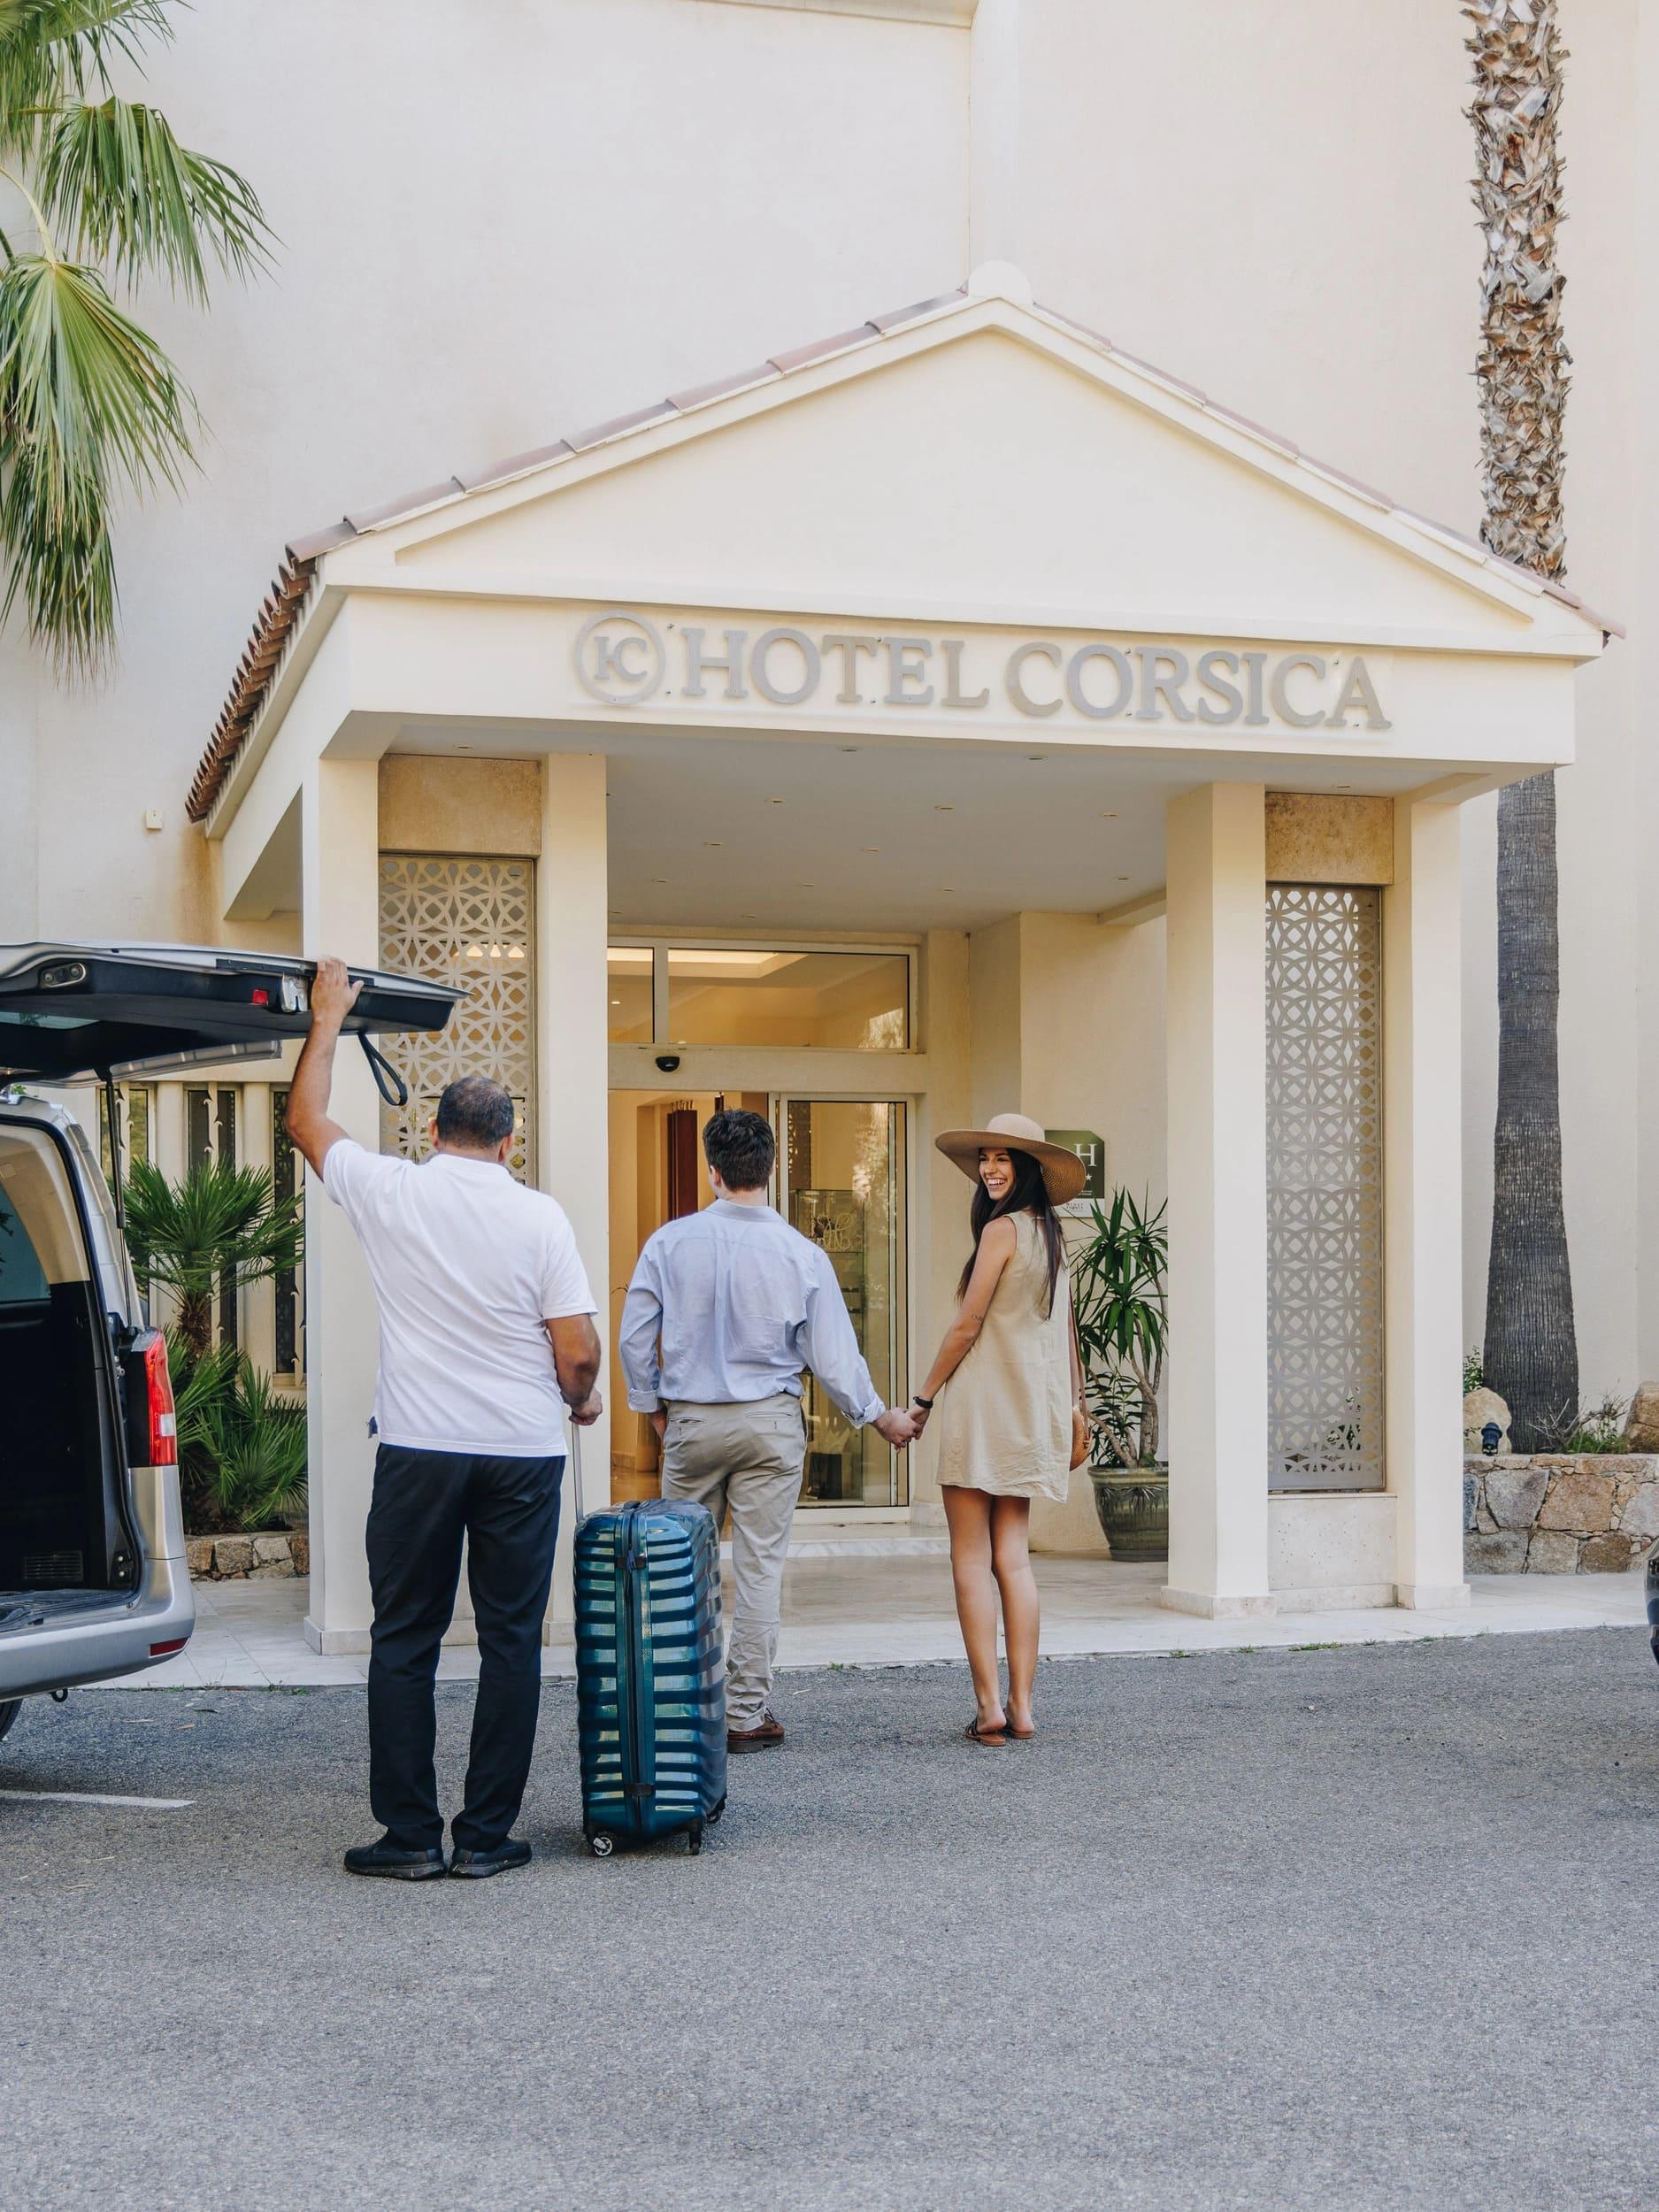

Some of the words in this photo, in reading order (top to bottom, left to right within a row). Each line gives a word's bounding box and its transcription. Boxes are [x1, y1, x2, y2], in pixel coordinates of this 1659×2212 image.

[680, 627, 990, 708] HOTEL
[1005, 641, 1393, 729] CORSICA
[1073, 1143, 1097, 1166] H
